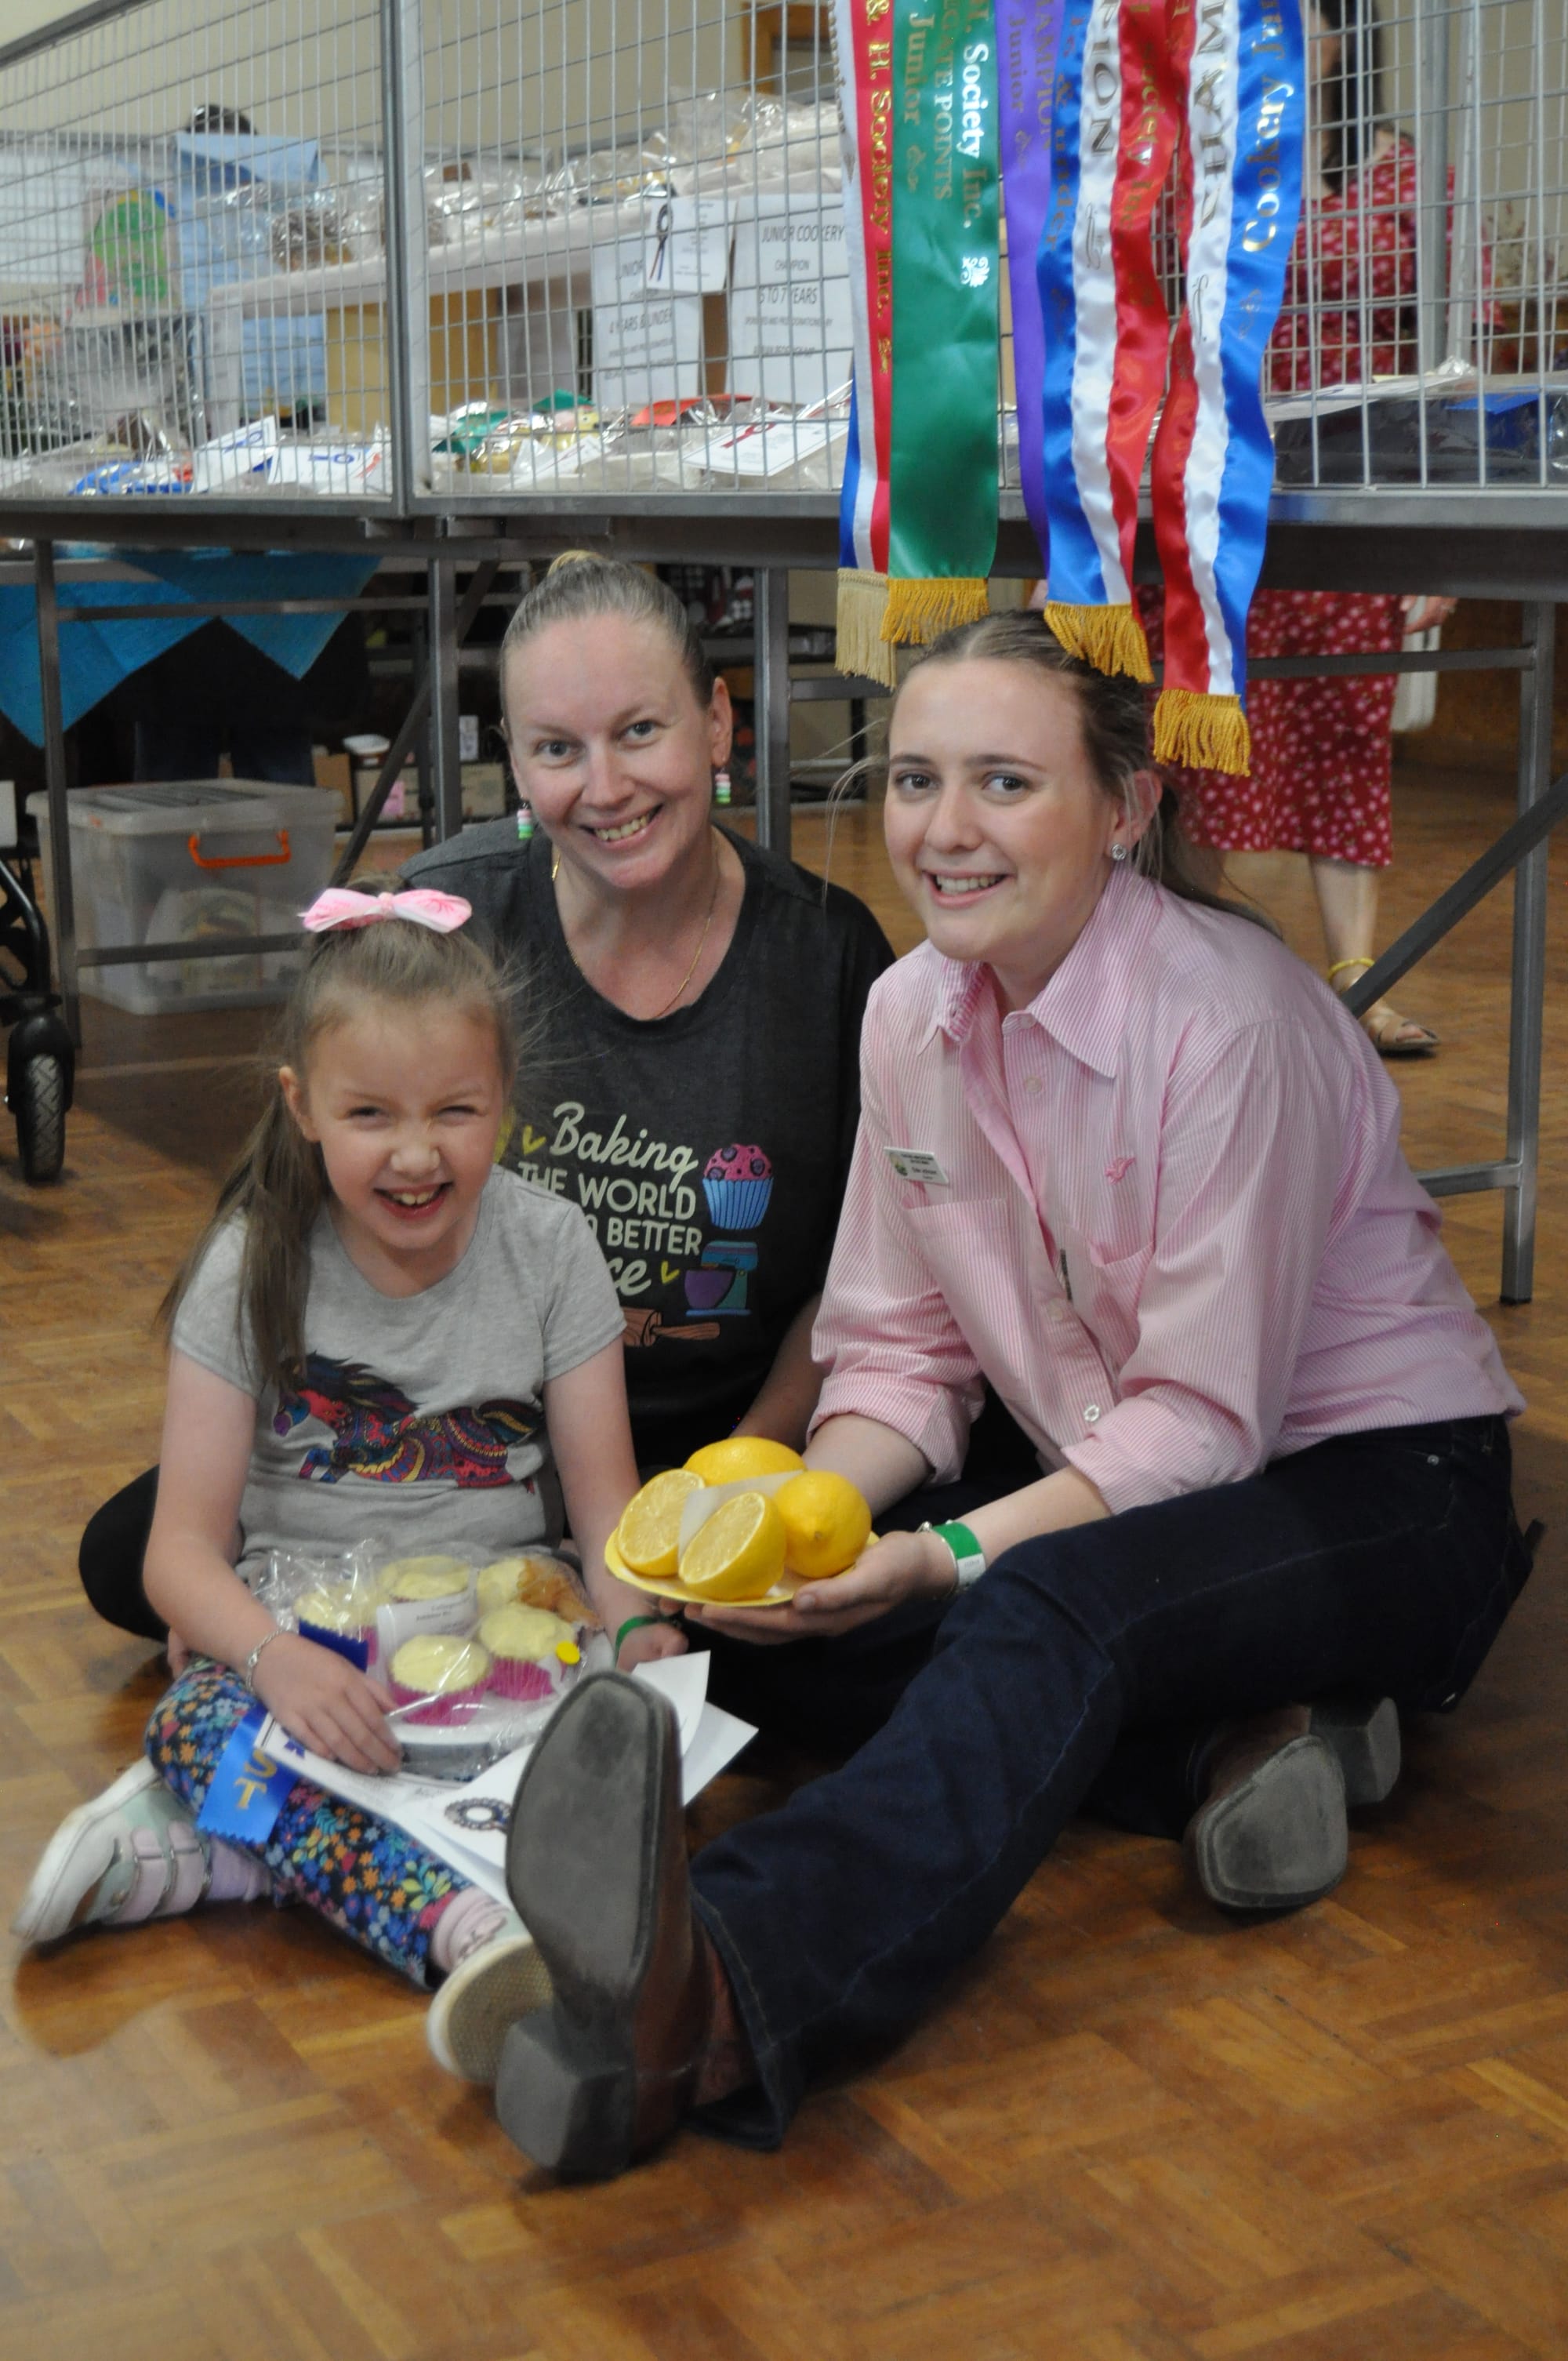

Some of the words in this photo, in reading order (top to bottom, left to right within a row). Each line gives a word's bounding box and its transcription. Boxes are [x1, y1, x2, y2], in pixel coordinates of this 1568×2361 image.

[904, 12, 935, 125] Junior
[956, 42, 990, 159] Society
[1008, 14, 1026, 114] Junior
[869, 89, 892, 235] Society
[934, 93, 953, 201] POINTS
[1242, 75, 1294, 252] Cookery
[963, 167, 988, 228] Inc.
[775, 260, 810, 271] CHAPION
[876, 249, 892, 318] Inc.
[517, 1161, 568, 1194] THE
[578, 1173, 697, 1221] WORLD
[550, 1101, 699, 1194] Baking
[606, 1216, 703, 1256] BETTER
